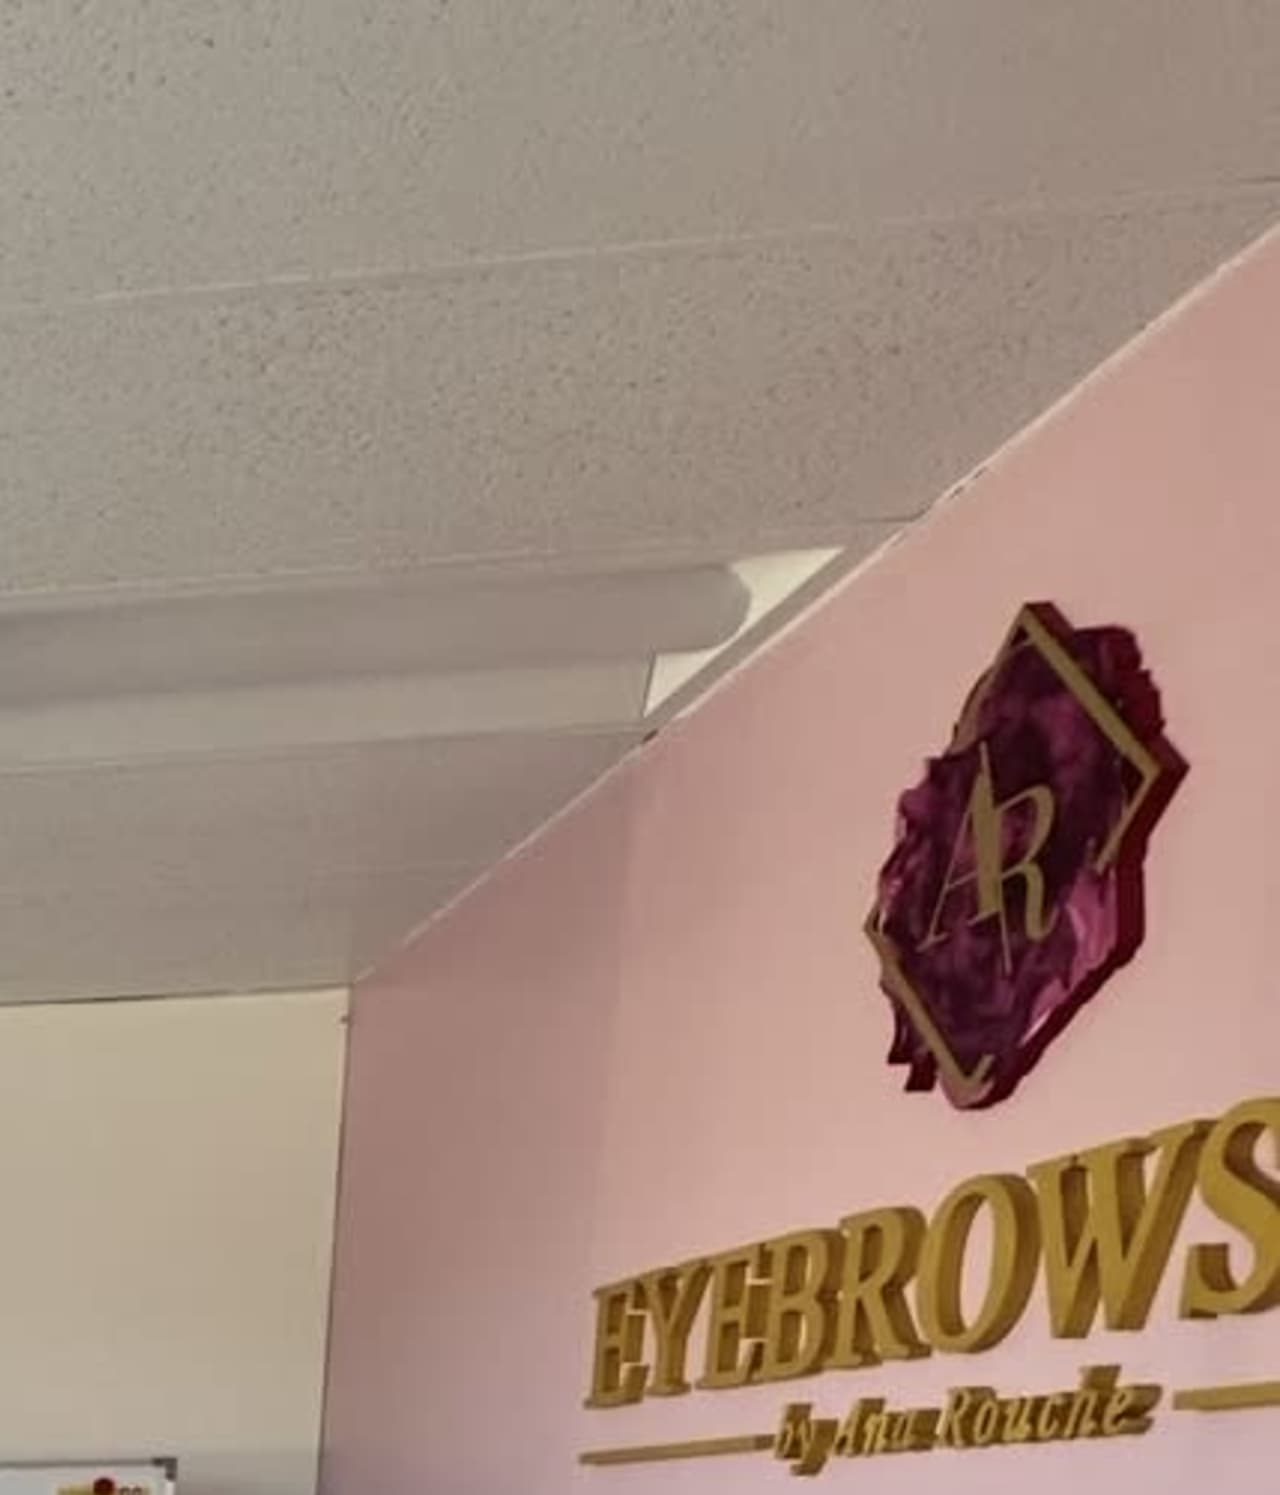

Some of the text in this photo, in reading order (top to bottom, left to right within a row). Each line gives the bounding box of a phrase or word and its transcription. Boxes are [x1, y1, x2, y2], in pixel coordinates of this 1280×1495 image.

[583, 1095, 1280, 1408] EYEBROWS
[774, 1403, 838, 1476] by
[939, 1364, 1162, 1447] Rouche
